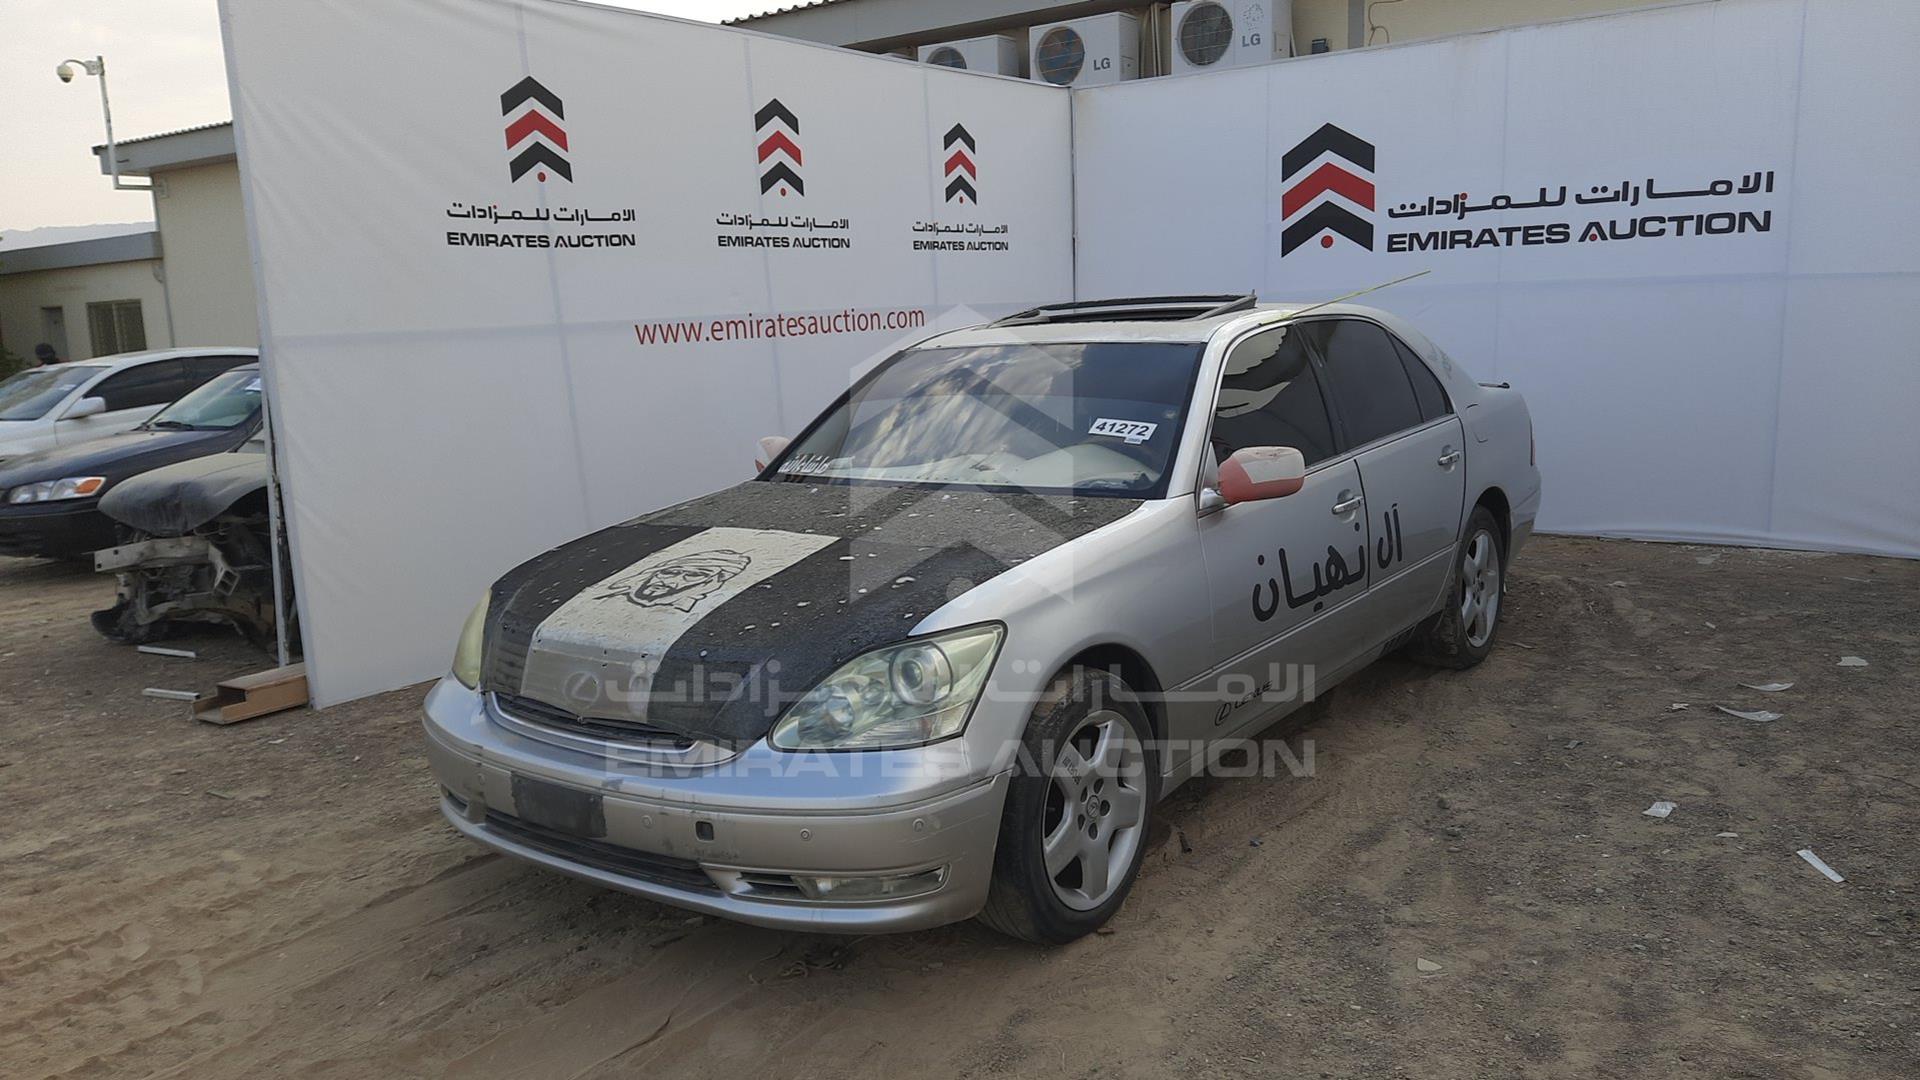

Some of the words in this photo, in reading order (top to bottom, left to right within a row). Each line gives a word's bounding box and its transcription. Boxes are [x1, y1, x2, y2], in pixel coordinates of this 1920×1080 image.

[1241, 32, 1262, 48] LG
[1092, 56, 1112, 72] LG
[1387, 223, 1571, 253] EMIRATES
[1578, 210, 1772, 242] AUCTION
[446, 231, 551, 249] EMIRATES
[553, 233, 636, 249] AUCTION
[717, 235, 791, 249] EMIRATES
[792, 236, 851, 249] AUCTION
[912, 240, 966, 251] EMIRATES
[966, 241, 1009, 251] AUCTION
[634, 307, 925, 345] www.emiratesauction.com
[1095, 422, 1150, 437] 41272
